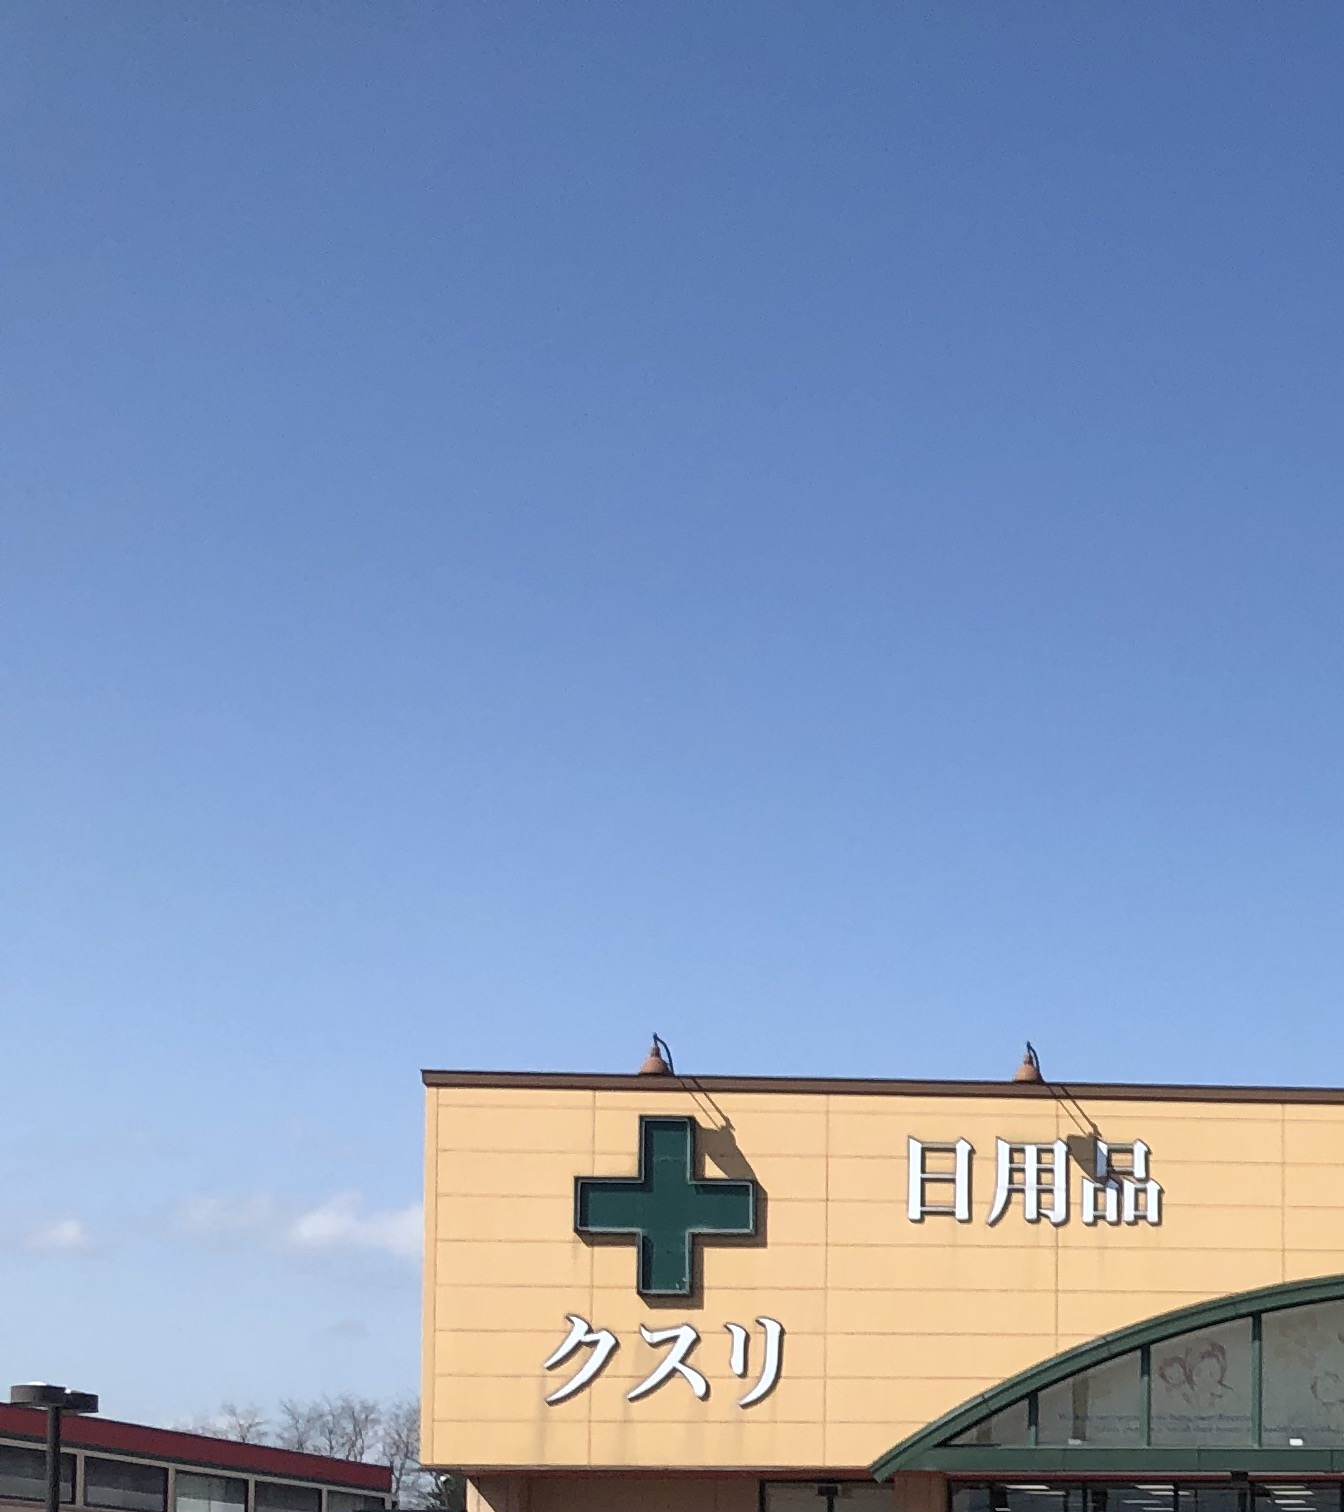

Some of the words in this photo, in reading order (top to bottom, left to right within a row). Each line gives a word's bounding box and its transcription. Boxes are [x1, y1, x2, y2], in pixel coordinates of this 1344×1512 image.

[906, 1135, 1165, 1227] 日用品
[543, 1313, 787, 1408] クスリ
